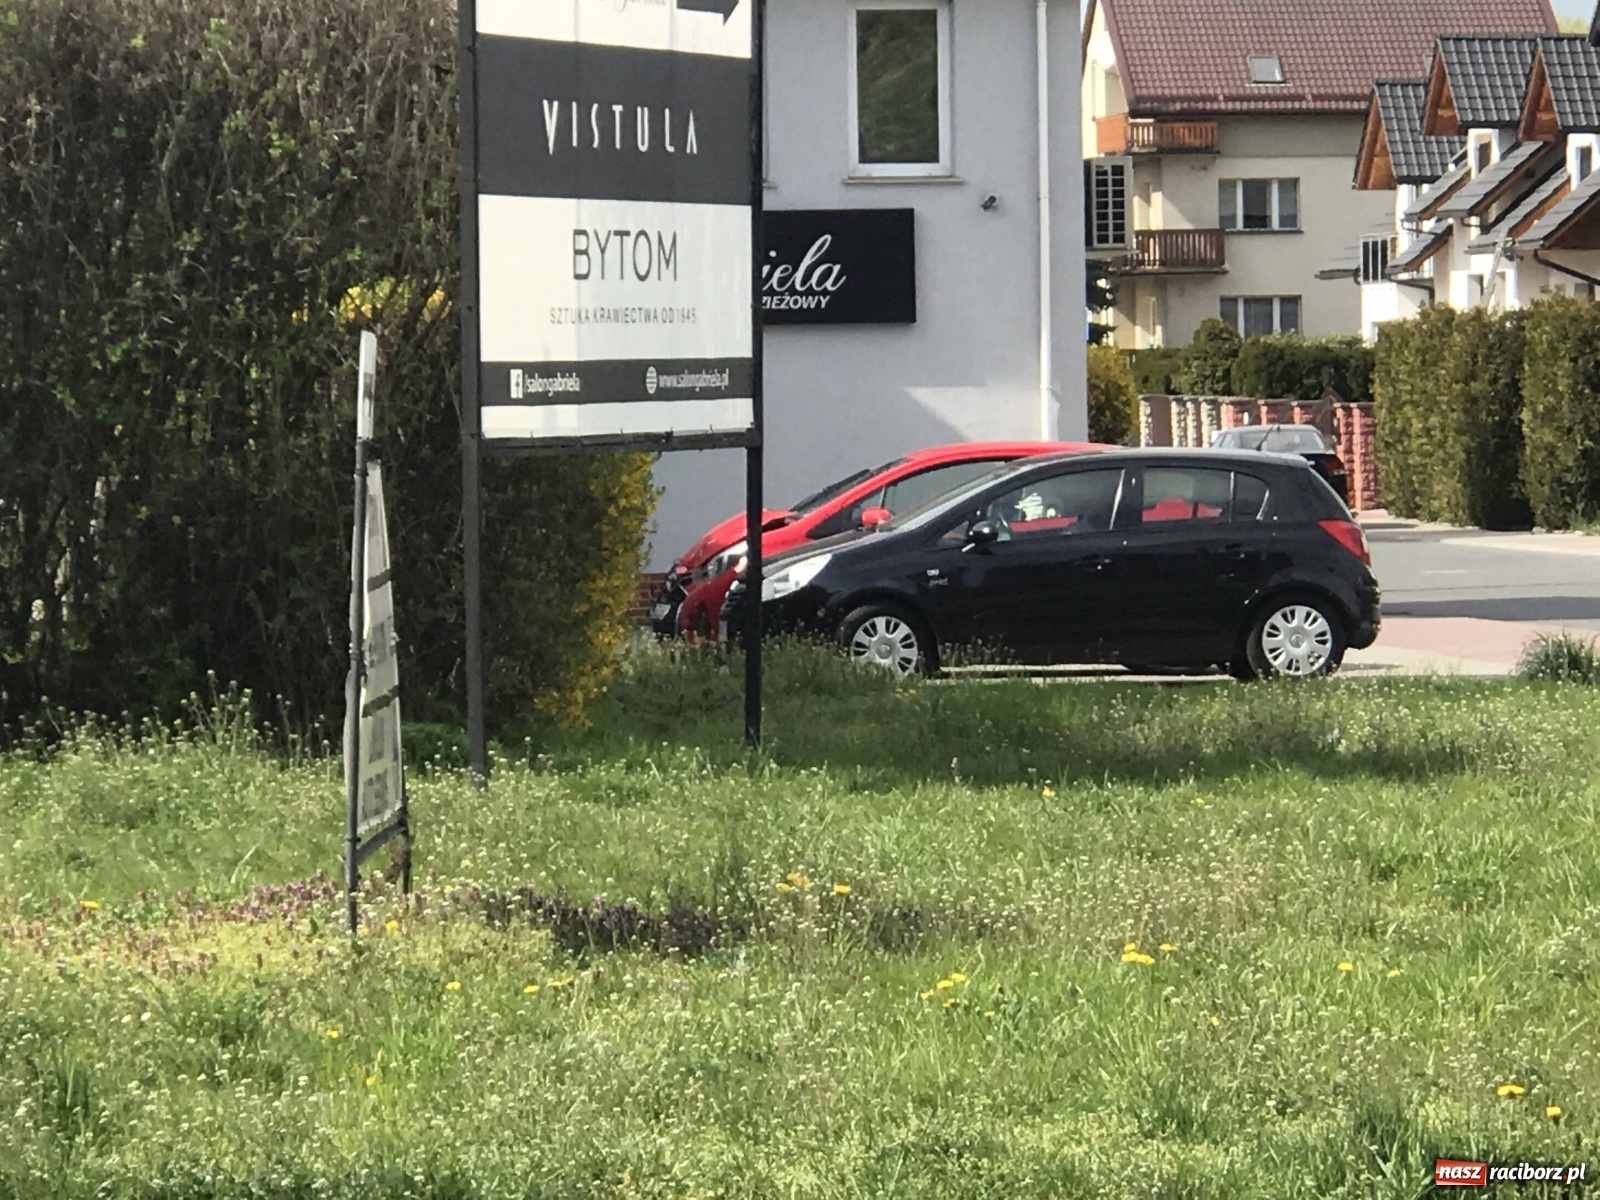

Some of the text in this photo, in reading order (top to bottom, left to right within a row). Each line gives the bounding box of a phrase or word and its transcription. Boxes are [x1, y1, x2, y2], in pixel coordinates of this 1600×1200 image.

[543, 99, 697, 155] VISTULA
[572, 229, 678, 281] BYTOM
[550, 307, 697, 325] SZTUKA KRAWIECTWA OD 1945
